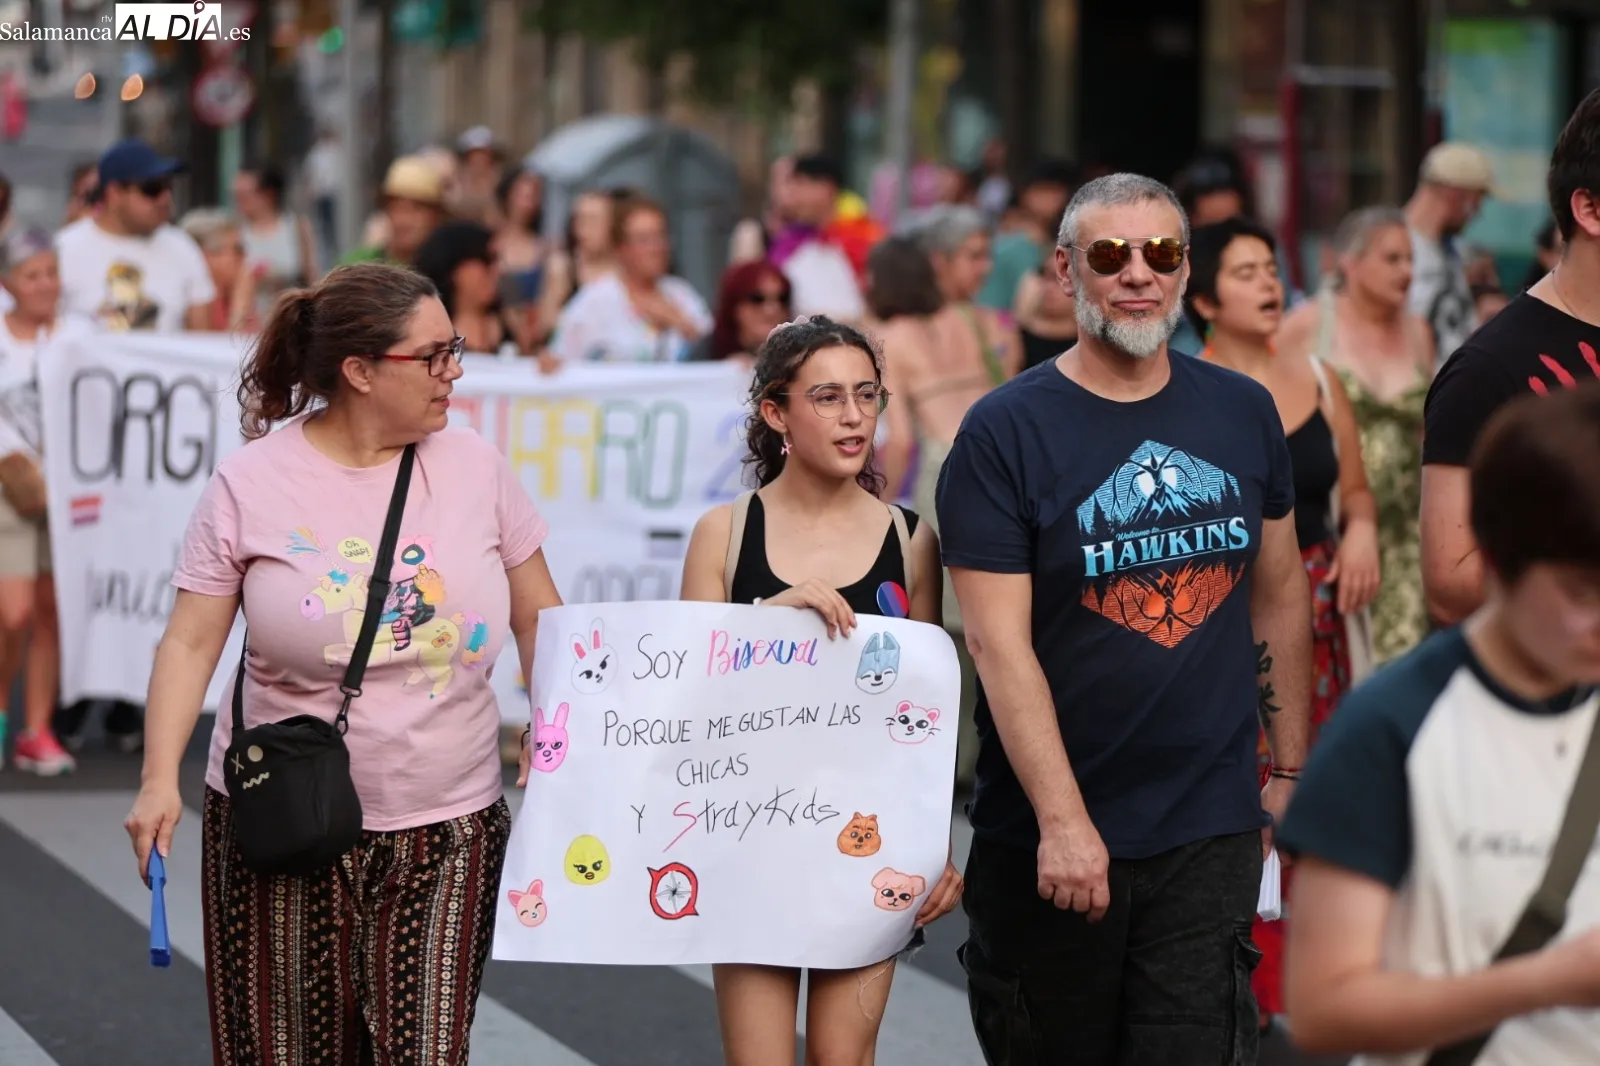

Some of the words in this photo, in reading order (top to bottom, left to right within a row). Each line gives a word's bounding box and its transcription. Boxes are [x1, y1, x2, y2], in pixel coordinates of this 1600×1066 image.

[70, 366, 217, 484] ORG
[1081, 516, 1249, 577] HAWKINS
[1115, 530, 1150, 541] Welcome
[707, 629, 818, 677] Bisexual
[603, 709, 693, 747] PORQUE
[827, 702, 862, 727] LAS
[676, 752, 749, 787] CHICAS
[630, 803, 646, 834] Y
